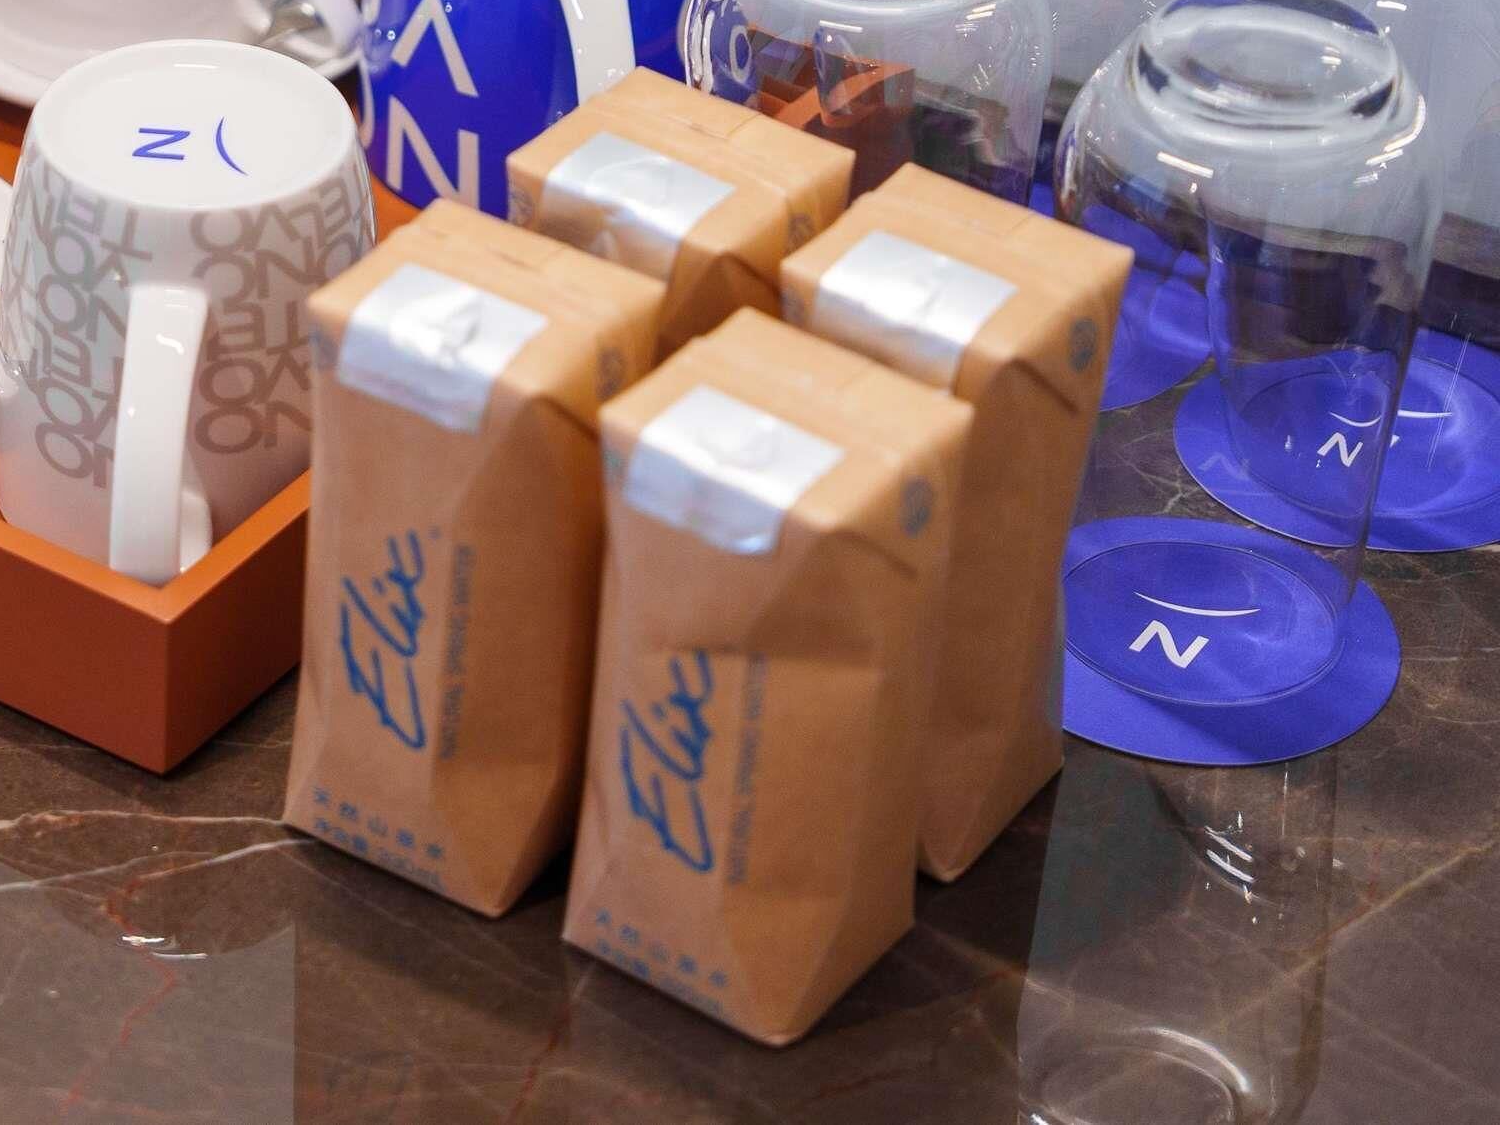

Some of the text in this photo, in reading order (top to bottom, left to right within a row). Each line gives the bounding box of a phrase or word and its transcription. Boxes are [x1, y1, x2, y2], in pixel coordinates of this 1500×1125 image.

[338, 530, 426, 752] Elix
[1129, 620, 1209, 668] N
[621, 647, 715, 872] Elix
